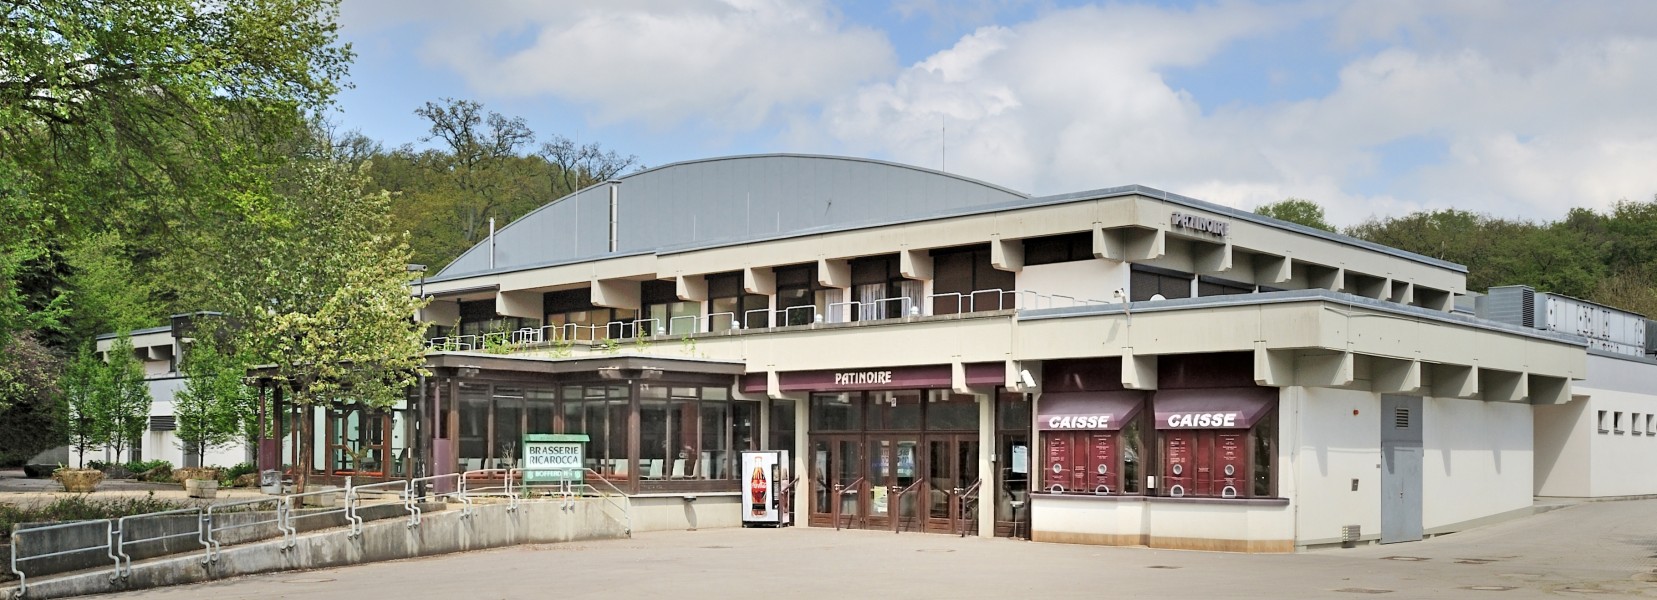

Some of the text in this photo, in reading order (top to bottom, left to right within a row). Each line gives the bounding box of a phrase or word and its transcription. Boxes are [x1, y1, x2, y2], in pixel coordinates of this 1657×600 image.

[1172, 211, 1229, 236] PATINOIRE
[835, 371, 891, 385] PATINOIRE
[1049, 415, 1109, 428] CAISSE
[1167, 413, 1236, 427] CAISSE
[529, 446, 578, 454] BRASSERIE
[529, 455, 578, 464] RICAROCCA
